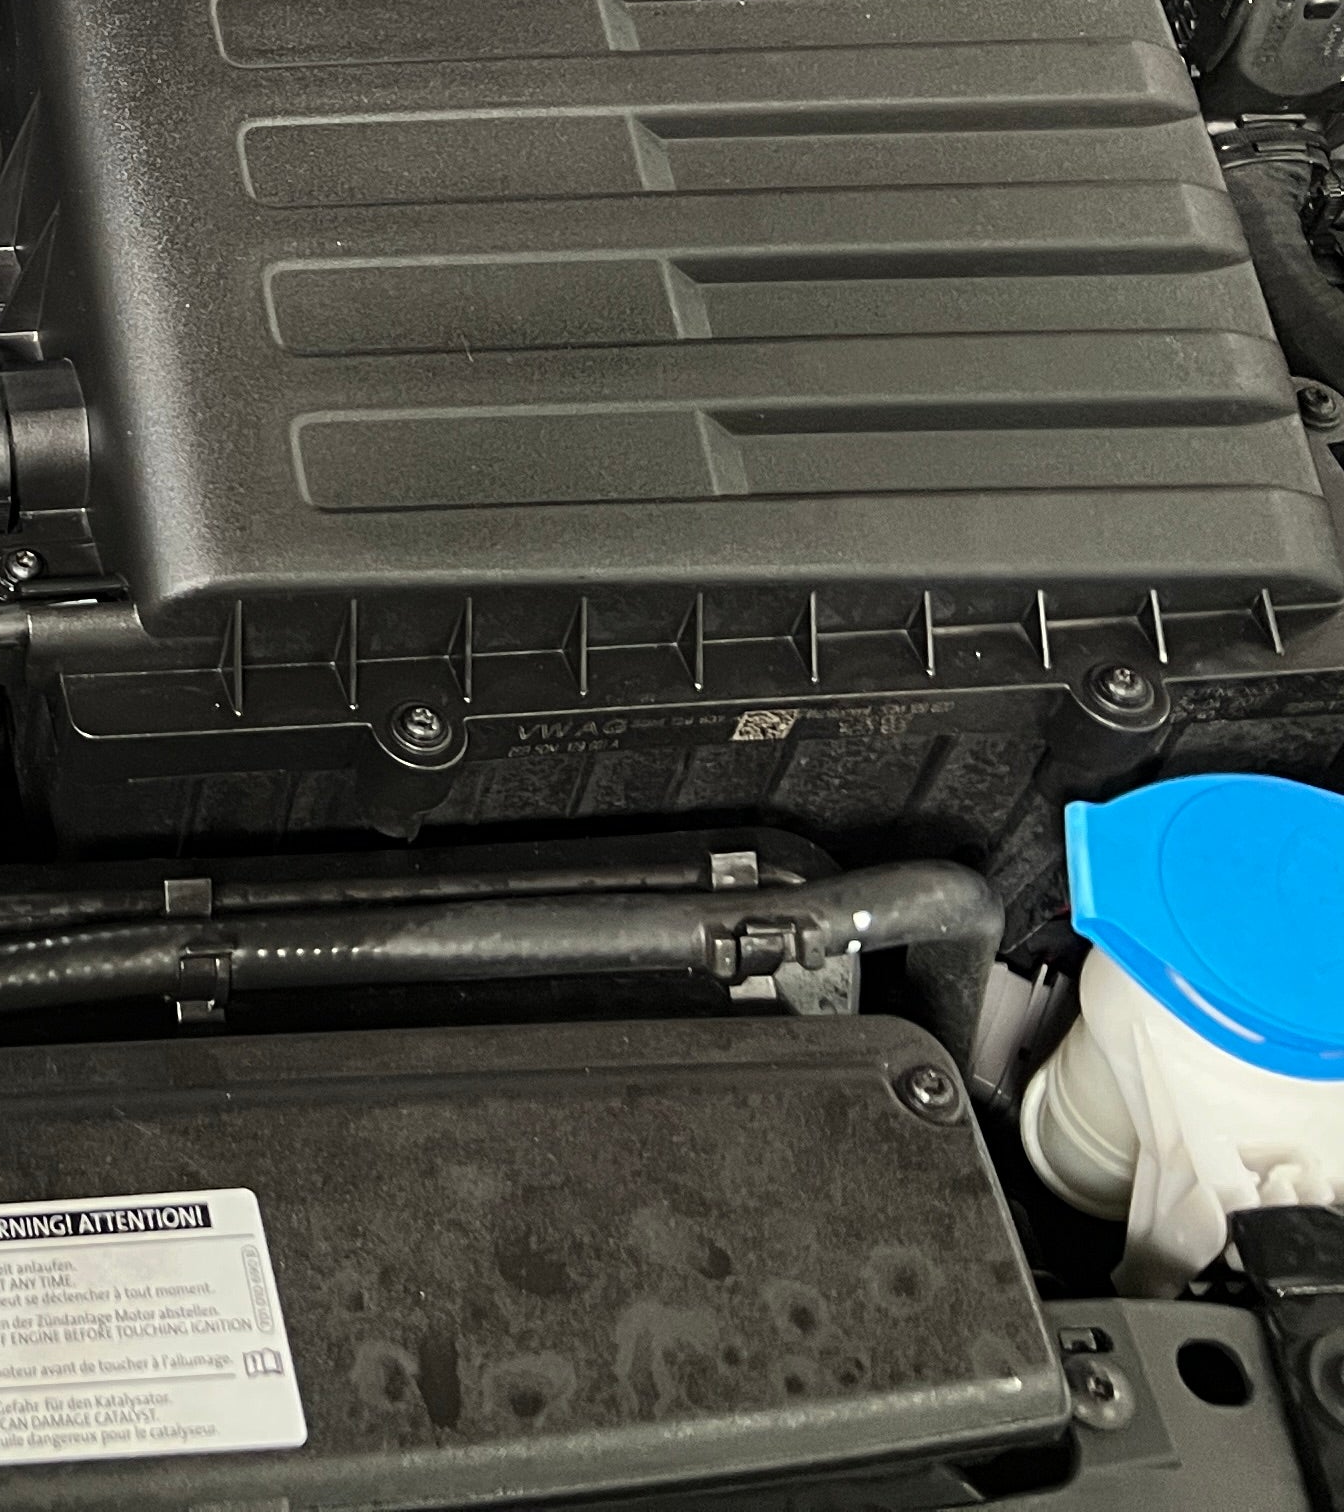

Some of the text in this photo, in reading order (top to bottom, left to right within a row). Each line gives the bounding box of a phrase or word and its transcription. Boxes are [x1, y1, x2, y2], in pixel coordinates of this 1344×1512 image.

[78, 1204, 203, 1234] ATTENTION!
[10, 1277, 35, 1291] ANY
[40, 1274, 74, 1288] TIME.
[125, 1285, 153, 1299] tout
[12, 1317, 34, 1329] der
[116, 1308, 155, 1322] Motor
[10, 1329, 61, 1346] ENGINE
[64, 1324, 115, 1341] BEFORE
[117, 1319, 188, 1339] TOUCHING
[40, 1363, 77, 1377] avant
[98, 1356, 149, 1371] toucher
[67, 1395, 92, 1410] den
[0, 1416, 28, 1431] CAN
[31, 1411, 91, 1428] DAMAGE
[101, 1427, 131, 1446] pour
